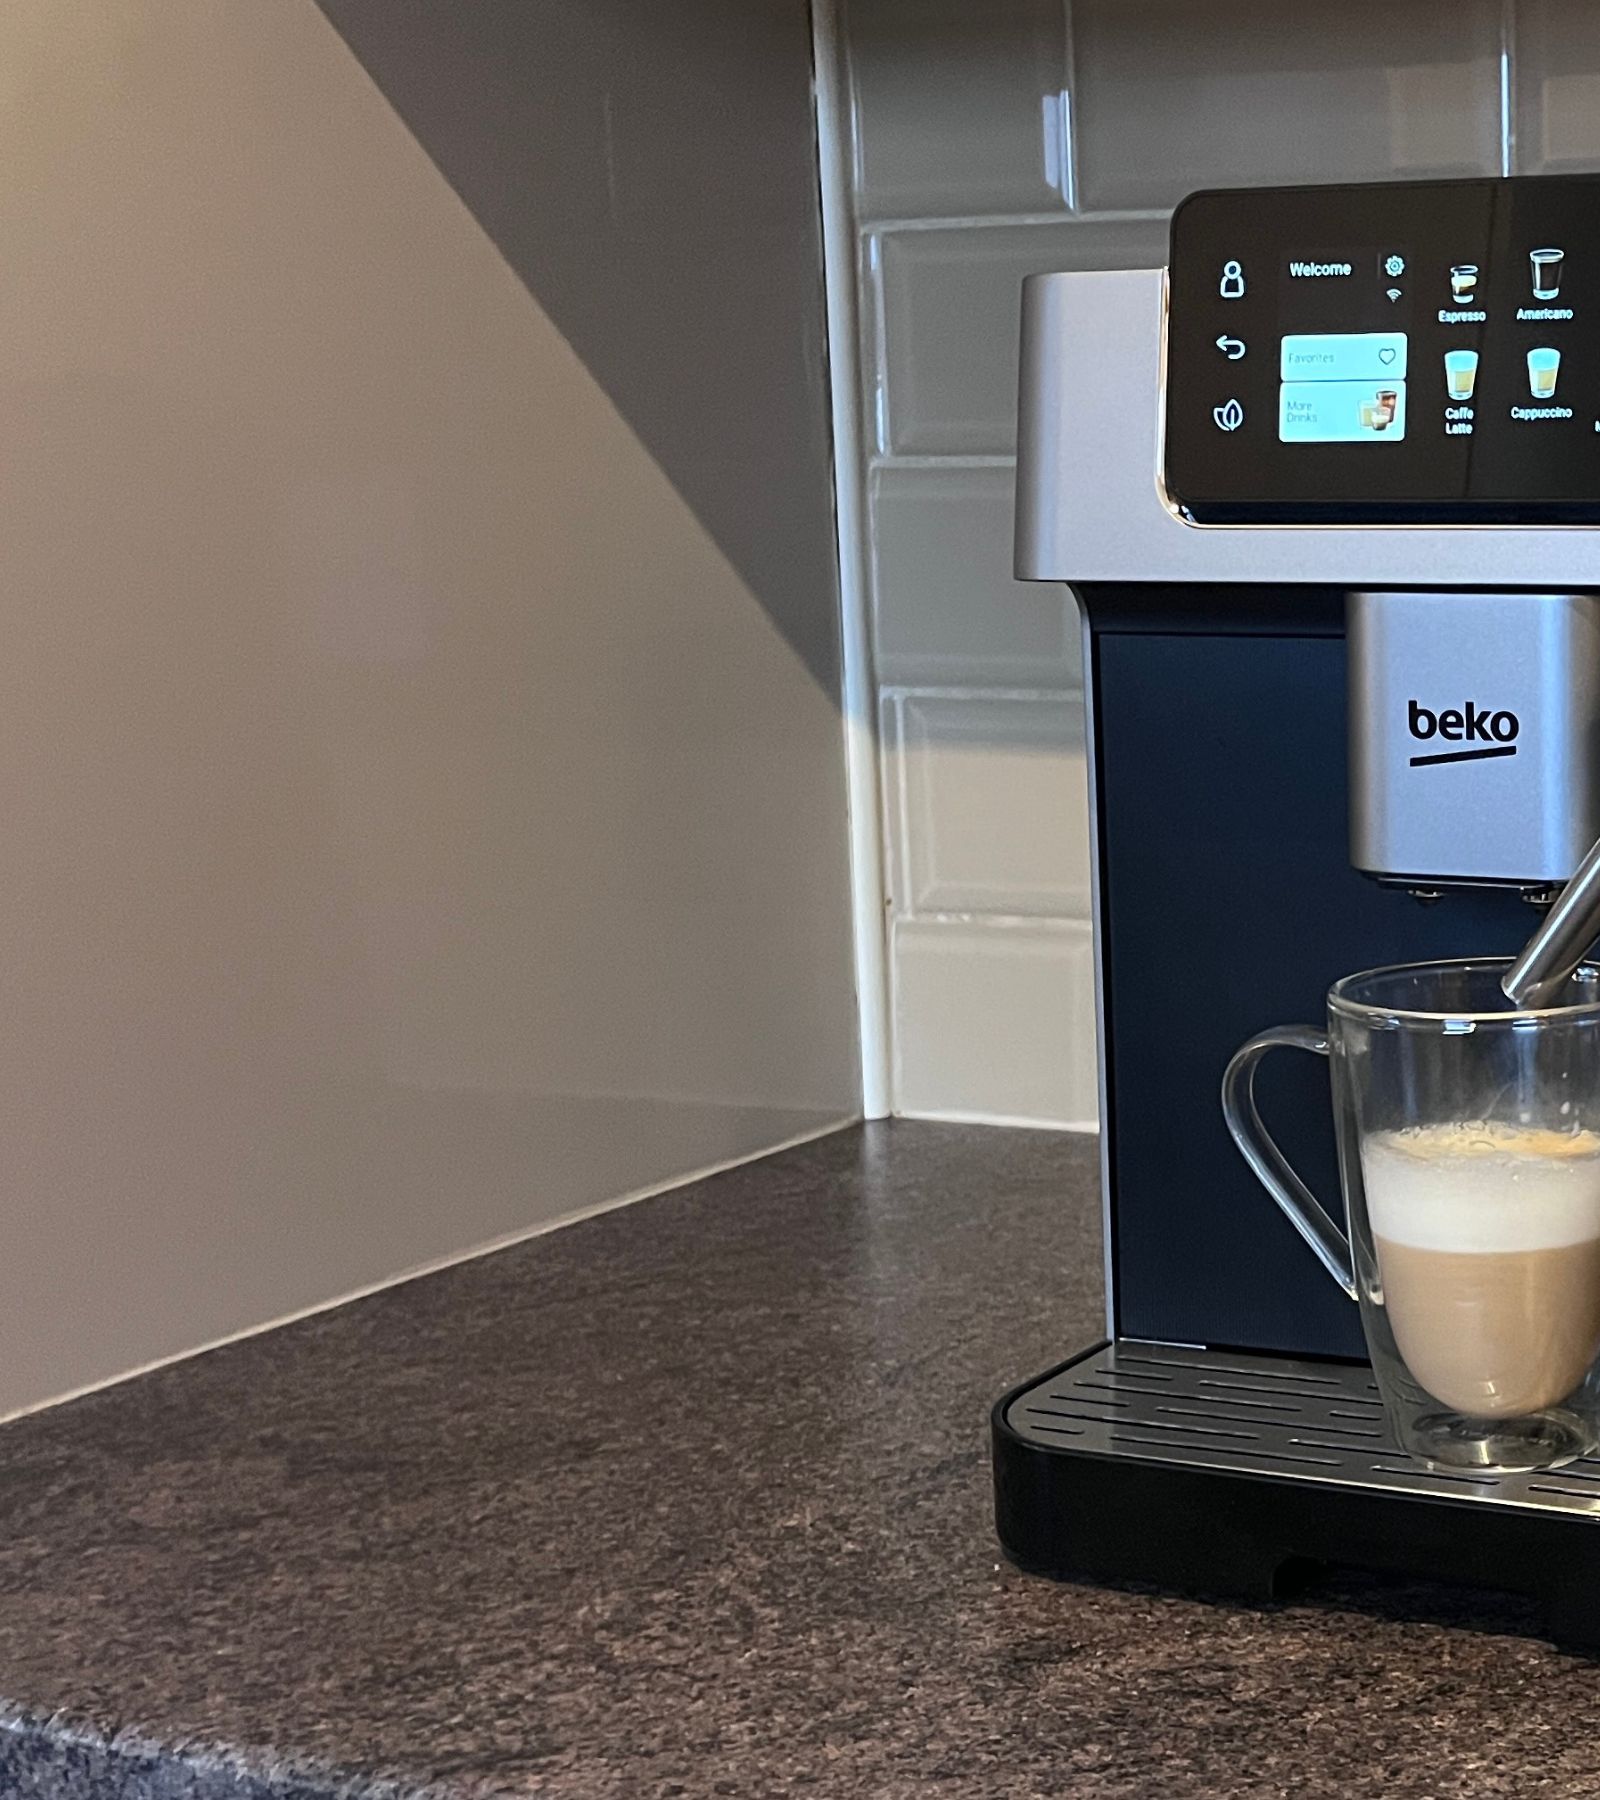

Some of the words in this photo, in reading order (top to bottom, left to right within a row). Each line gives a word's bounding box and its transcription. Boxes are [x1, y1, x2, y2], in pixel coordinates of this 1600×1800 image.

[1289, 262, 1352, 277] Welcome
[1438, 310, 1486, 324] Espresso
[1516, 308, 1573, 320] Americano
[1288, 353, 1335, 363] Favorites
[1287, 401, 1312, 411] More
[1286, 412, 1318, 423] Drinks
[1445, 407, 1474, 420] Caffe
[1511, 406, 1573, 421] Cappuccino
[1445, 422, 1473, 435] Latte
[1408, 700, 1520, 743] beko
